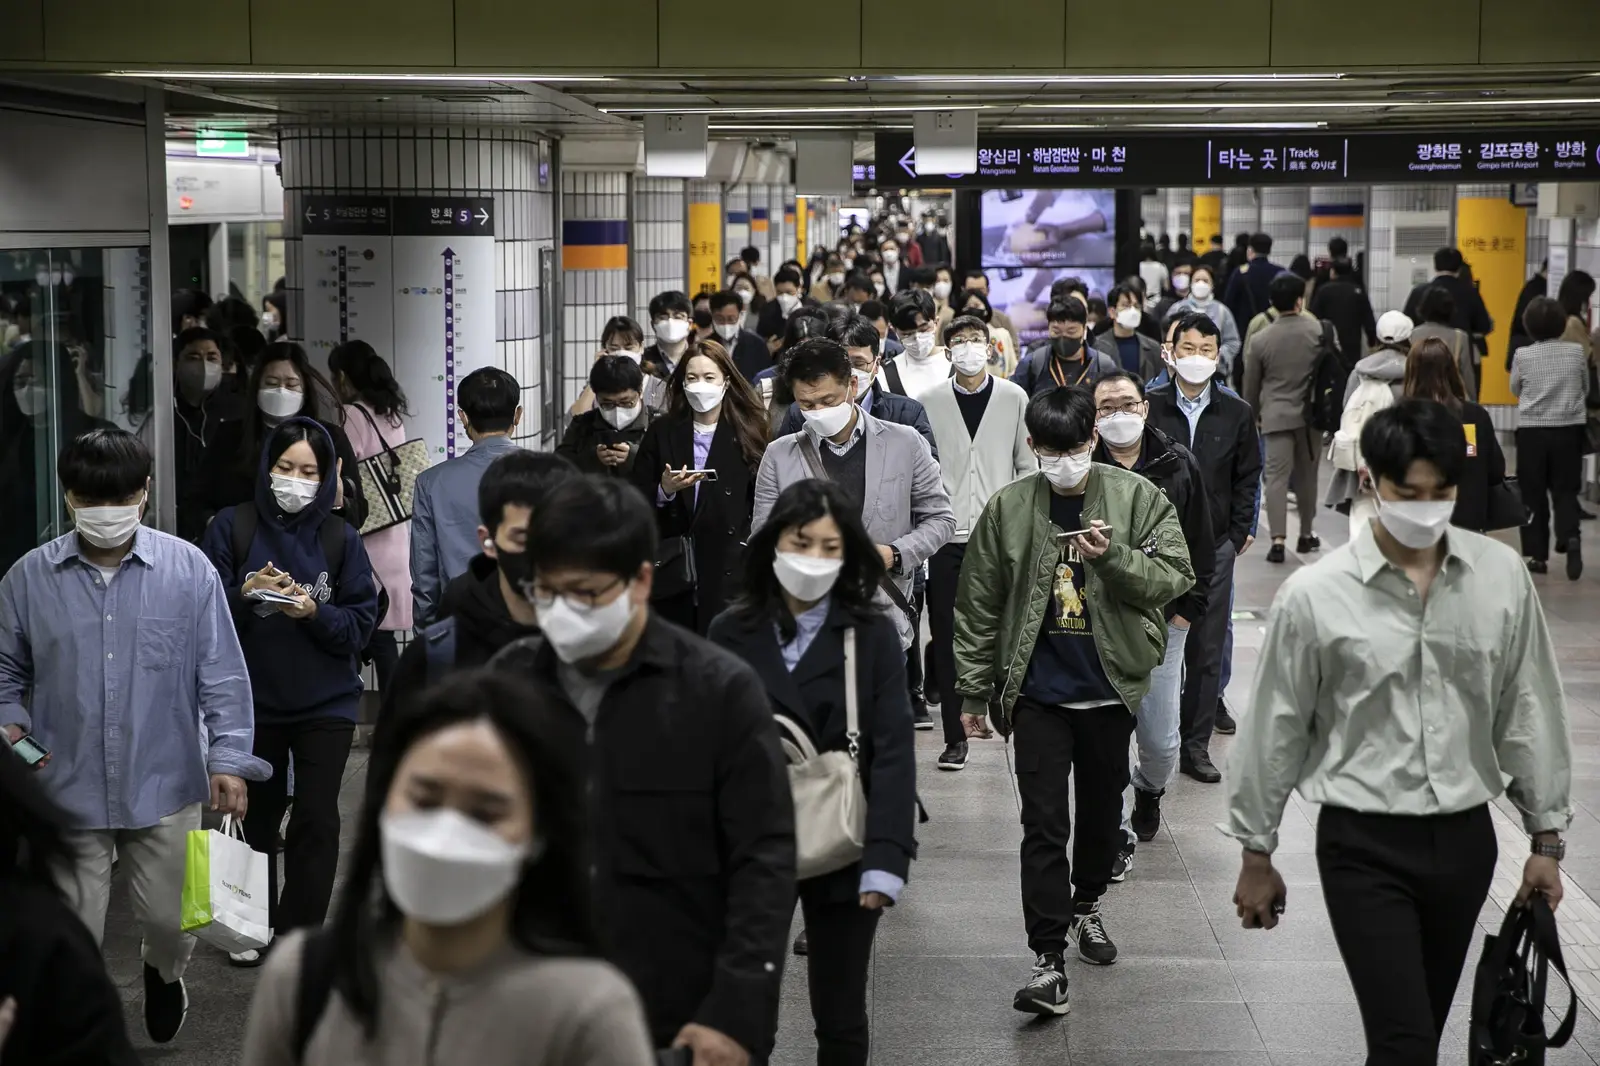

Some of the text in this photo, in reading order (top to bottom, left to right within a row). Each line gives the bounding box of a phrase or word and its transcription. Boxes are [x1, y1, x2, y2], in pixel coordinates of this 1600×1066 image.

[978, 149, 1021, 165] 왕십리
[1033, 147, 1080, 164] 하남검단산
[1289, 147, 1319, 158] Tracks
[1417, 141, 1587, 161] 광화문 김포공항 방화
[1219, 148, 1278, 169] 타는 곳
[1093, 165, 1124, 173] Macheon
[1477, 162, 1500, 171] Gimpo
[1514, 160, 1539, 170] Airport
[1554, 160, 1586, 170] Banghwa
[980, 167, 1016, 176] Wangsimni
[460, 210, 468, 222] 5
